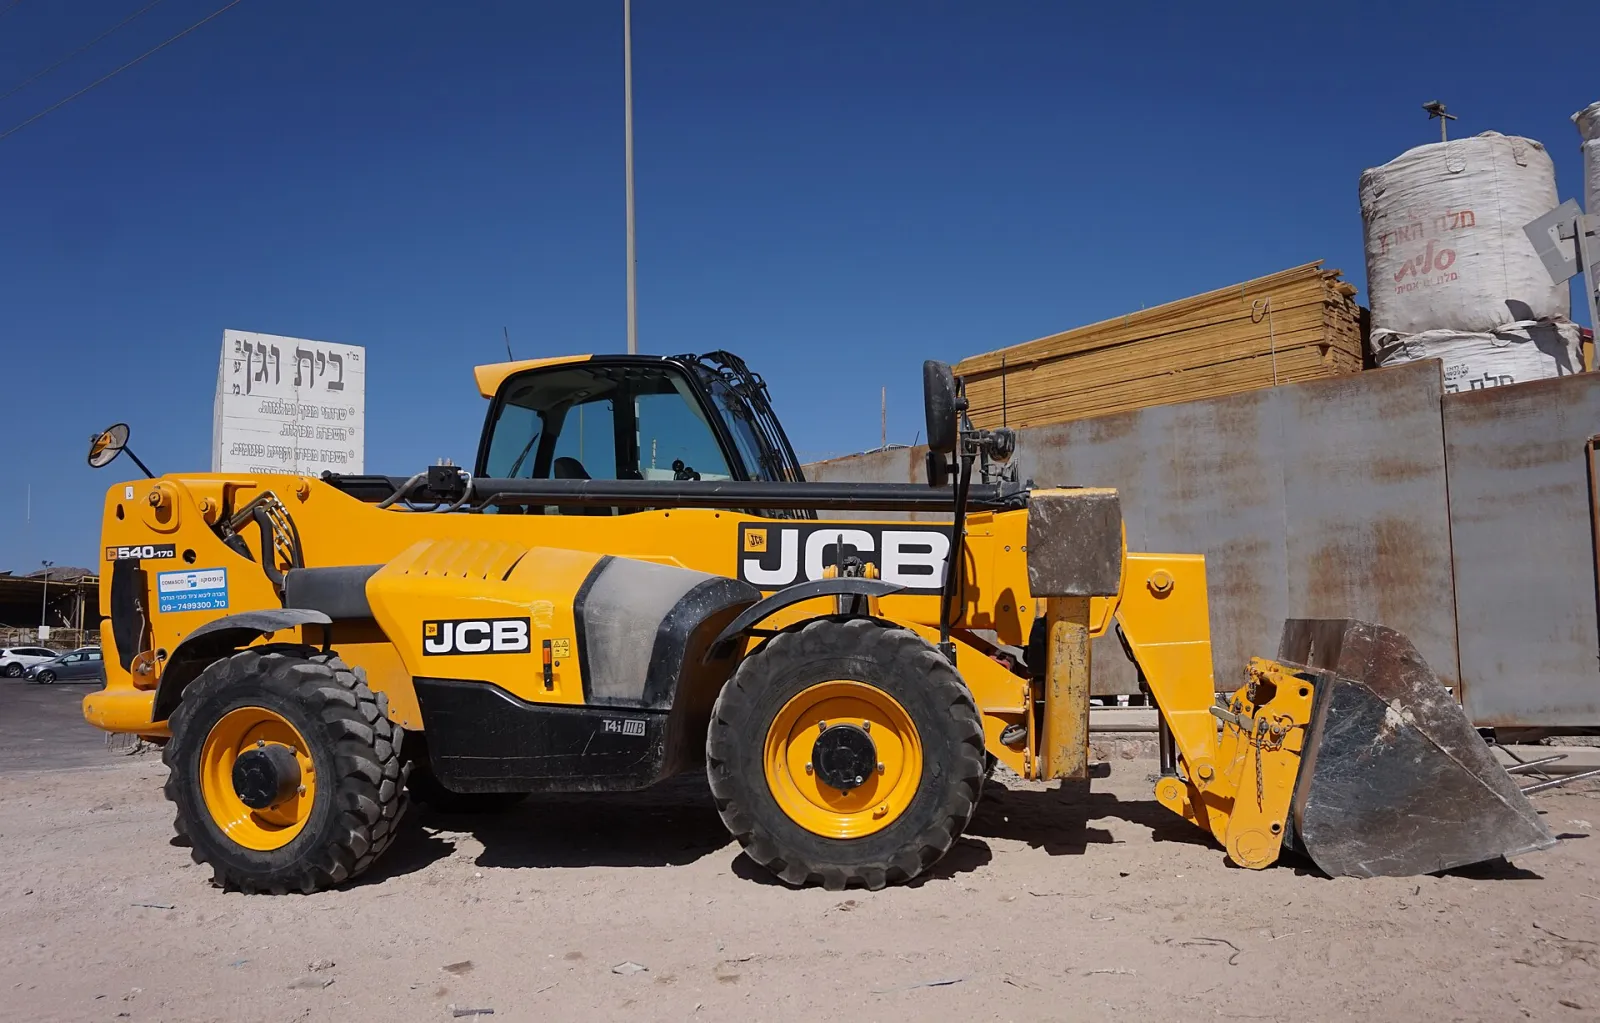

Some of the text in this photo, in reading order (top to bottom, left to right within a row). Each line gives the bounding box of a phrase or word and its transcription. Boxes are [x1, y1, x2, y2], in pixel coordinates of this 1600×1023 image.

[243, 339, 344, 395] בית וגן
[743, 529, 950, 588] JCB
[161, 579, 185, 587] COMASCO
[161, 601, 212, 612] 09-7499300
[425, 620, 529, 653] JCB
